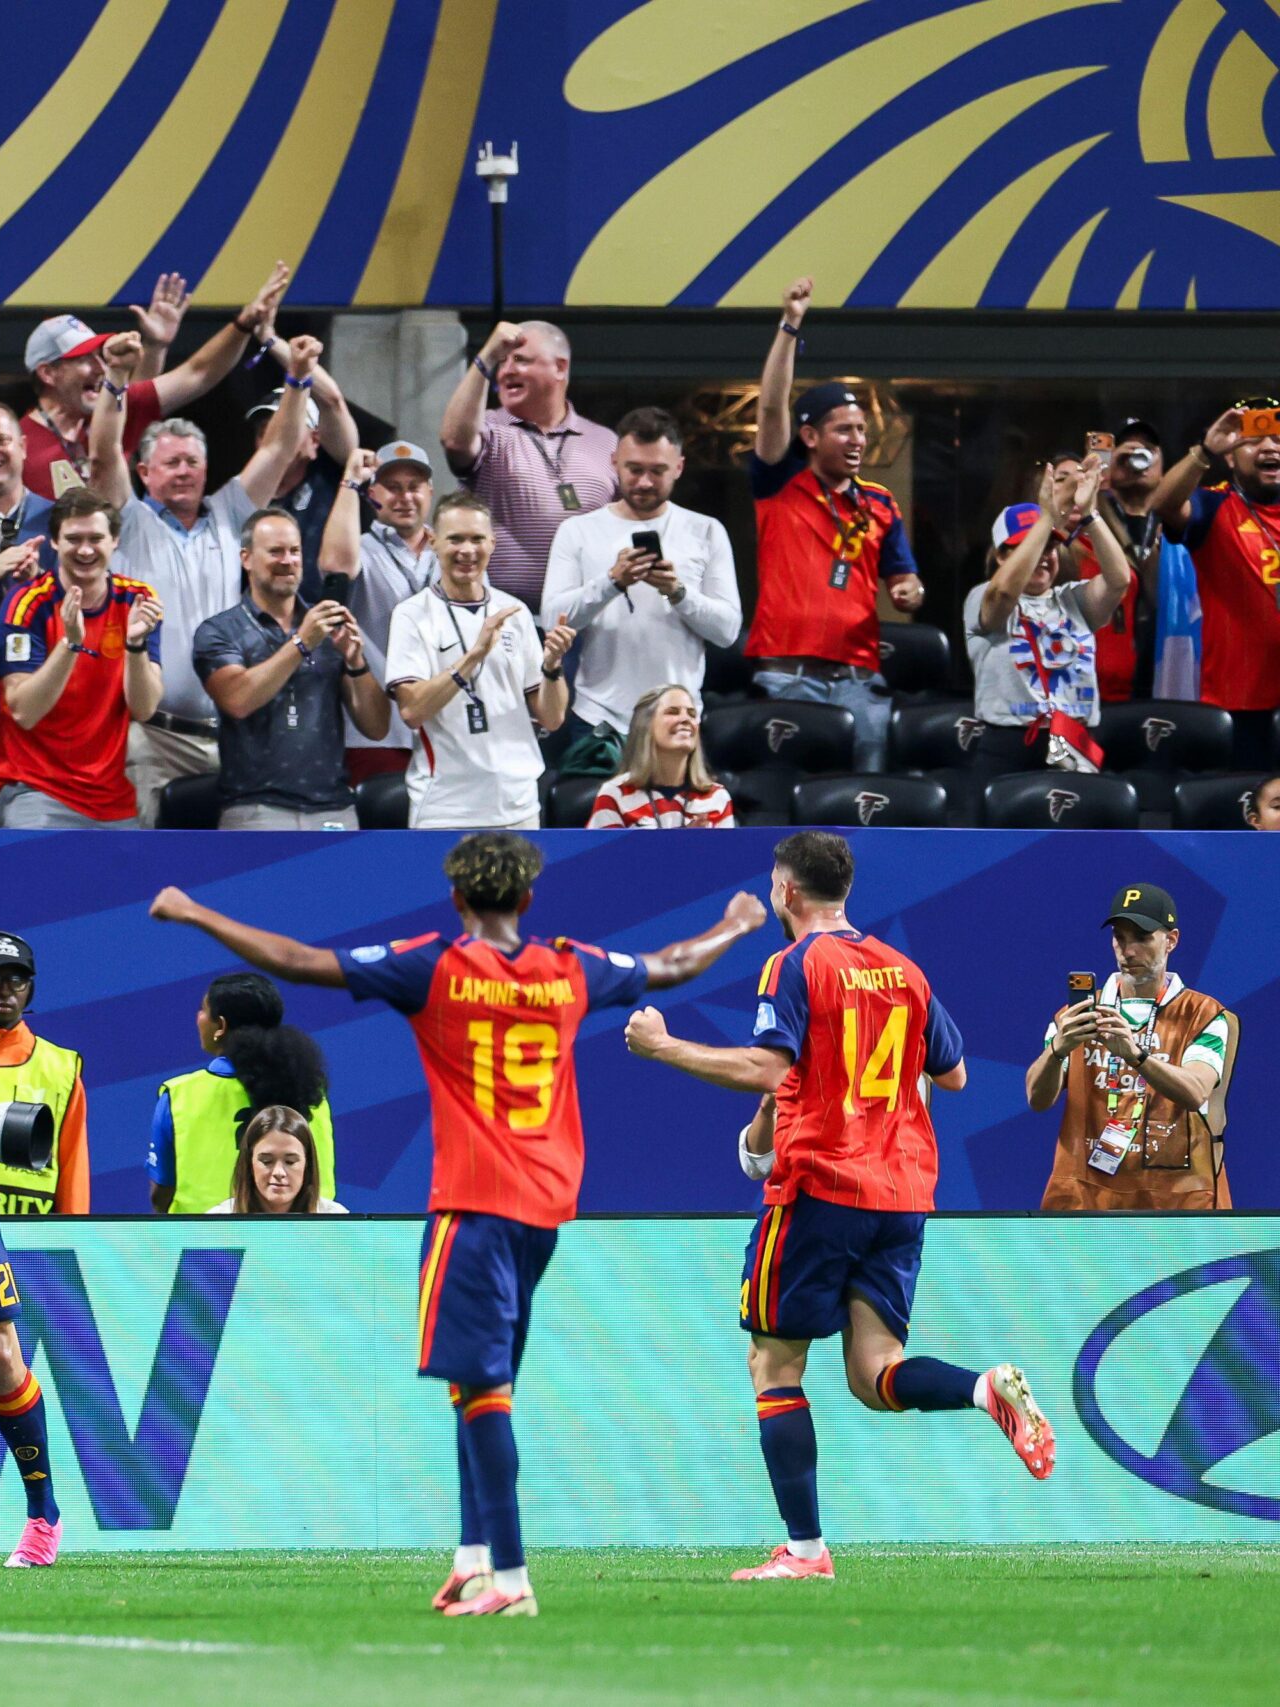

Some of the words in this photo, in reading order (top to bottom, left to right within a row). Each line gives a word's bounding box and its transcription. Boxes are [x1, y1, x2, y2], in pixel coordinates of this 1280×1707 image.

[1123, 889, 1141, 908] P
[449, 975, 519, 1008] LAMINE
[839, 966, 907, 991] LAORTE
[468, 1020, 560, 1130] 19
[843, 1006, 909, 1115] 14
